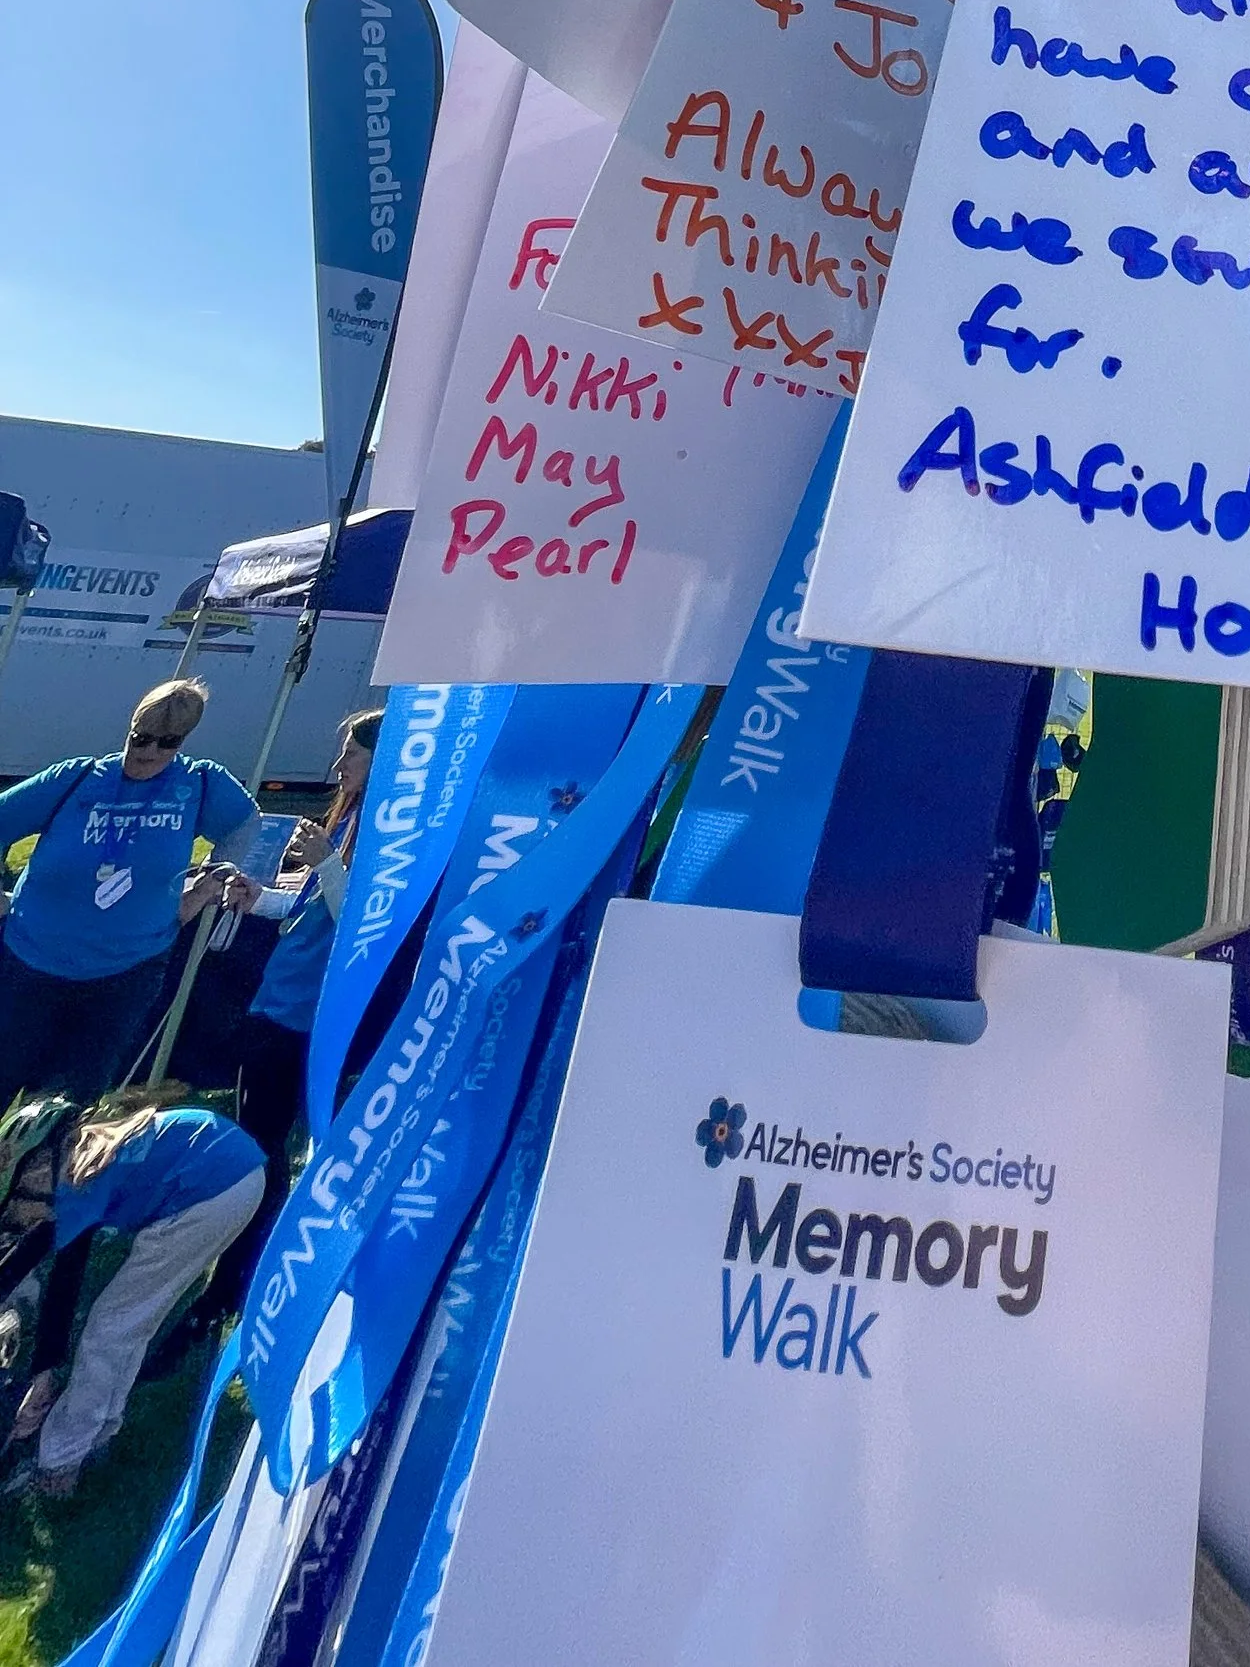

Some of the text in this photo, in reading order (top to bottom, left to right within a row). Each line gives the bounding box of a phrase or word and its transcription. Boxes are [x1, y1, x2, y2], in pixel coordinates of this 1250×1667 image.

[991, 6, 1179, 95] have
[979, 110, 1156, 175] and
[951, 199, 1084, 263] we
[326, 307, 390, 331] Alzheimer's
[331, 323, 375, 346] Society
[484, 333, 686, 422] Nikki
[465, 415, 625, 528] May
[441, 505, 638, 585] Pearl
[427, 732, 478, 828] Society
[247, 914, 497, 1381] MemoryWalk
[744, 1123, 1057, 1205] Alzheimer's Society
[723, 1176, 1049, 1317] Memory
[721, 1267, 879, 1379] Walk
